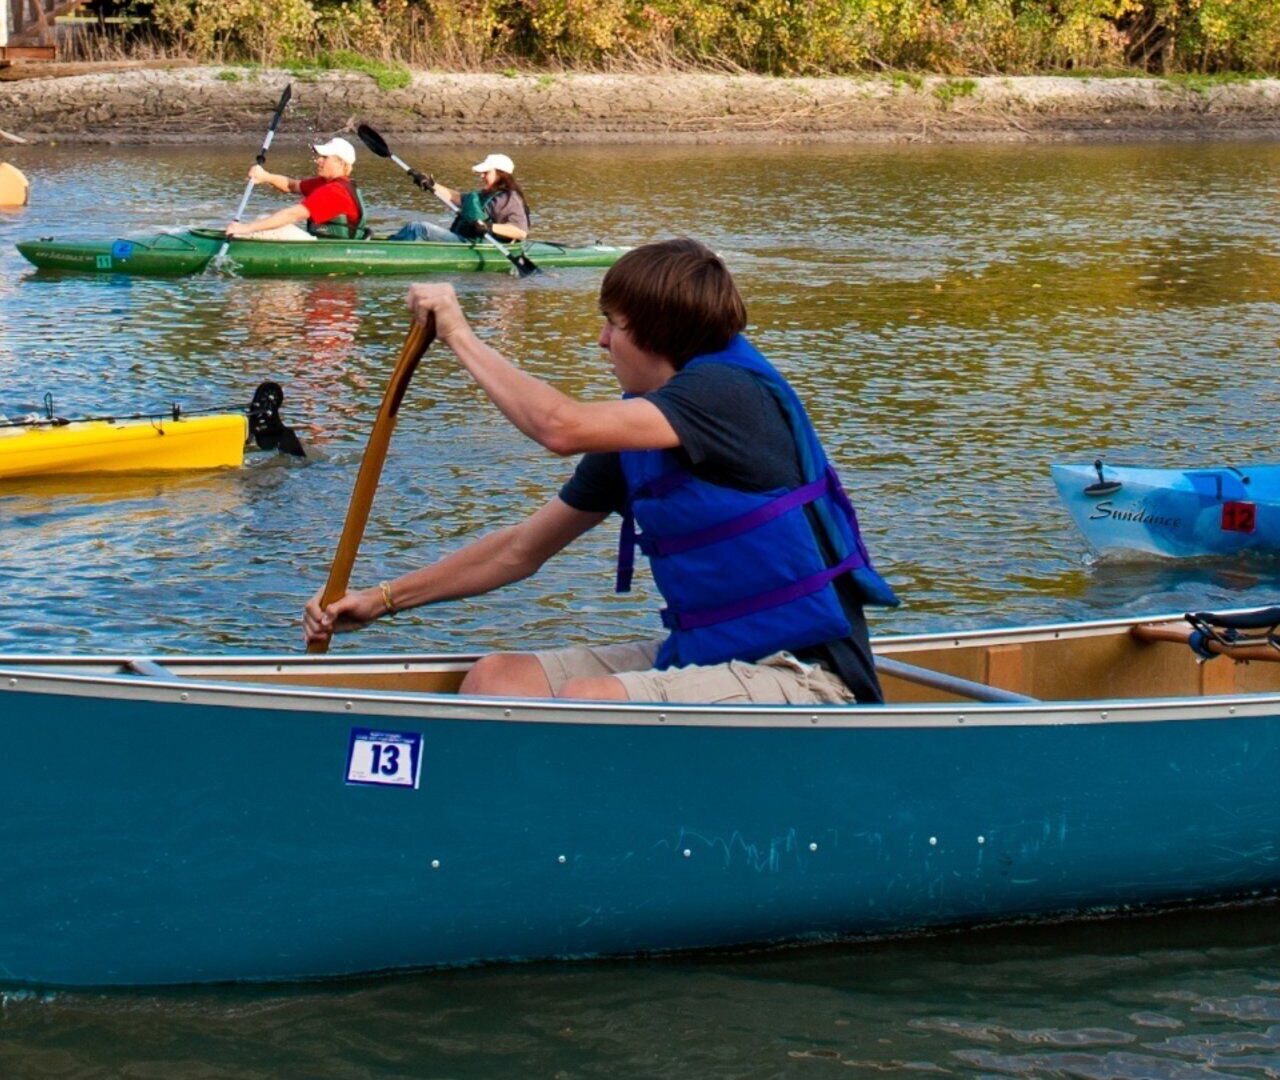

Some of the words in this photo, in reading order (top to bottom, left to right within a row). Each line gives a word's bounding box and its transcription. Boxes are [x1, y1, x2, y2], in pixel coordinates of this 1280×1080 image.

[1089, 501, 1183, 527] Sundance
[1225, 508, 1252, 530] 12
[371, 743, 400, 776] 13
